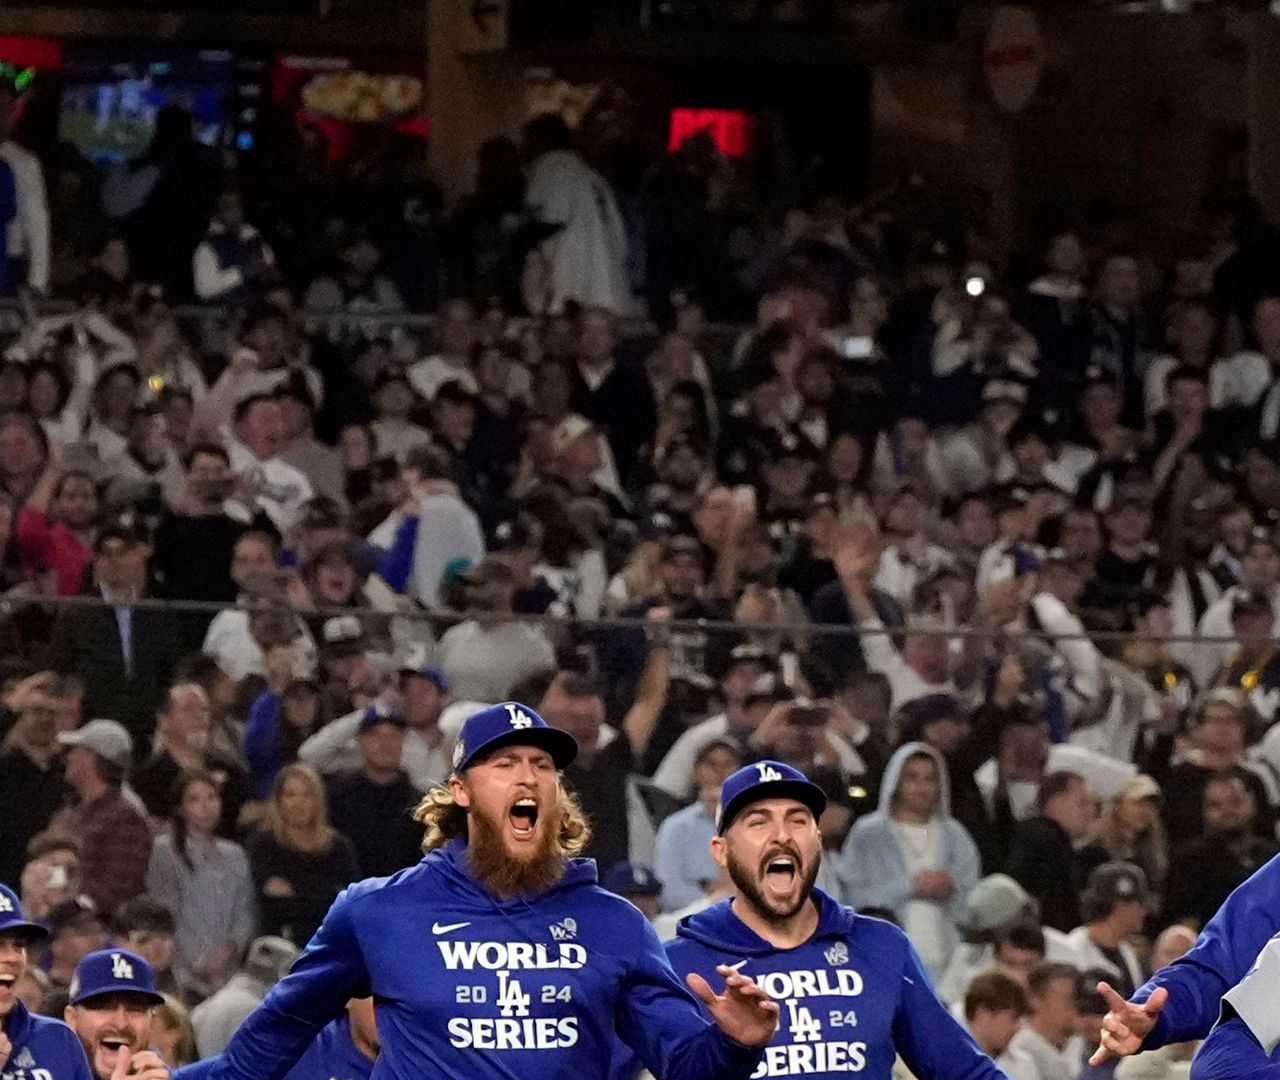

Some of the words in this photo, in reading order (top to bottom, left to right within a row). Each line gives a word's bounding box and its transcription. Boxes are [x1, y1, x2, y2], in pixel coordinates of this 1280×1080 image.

[504, 704, 532, 729] LA
[755, 762, 783, 782] LA
[110, 953, 134, 980] LA
[437, 941, 588, 969] WORLD
[455, 985, 487, 1003] 20
[497, 970, 530, 1016] LA
[541, 985, 572, 1003] 24
[447, 1017, 578, 1050] SERIES
[785, 999, 822, 1042] LA
[829, 1010, 857, 1027] 24
